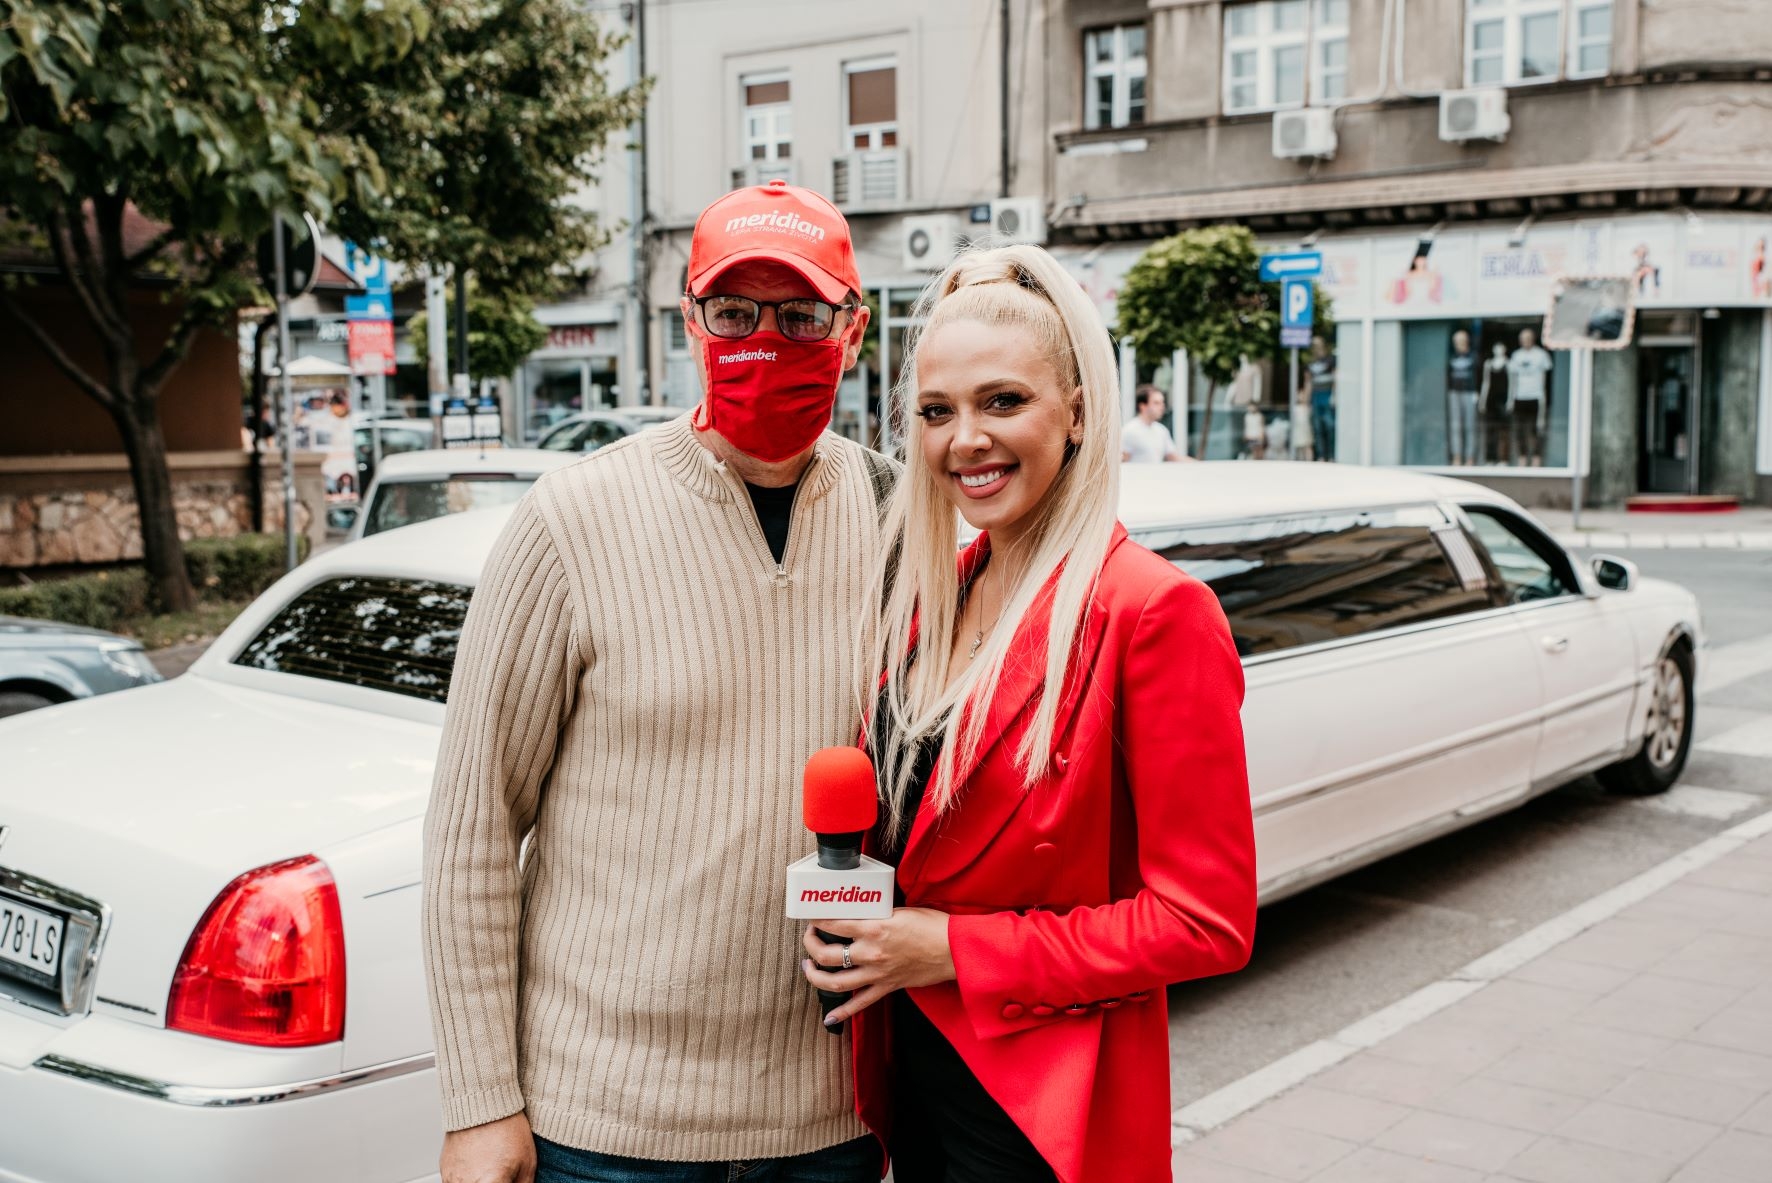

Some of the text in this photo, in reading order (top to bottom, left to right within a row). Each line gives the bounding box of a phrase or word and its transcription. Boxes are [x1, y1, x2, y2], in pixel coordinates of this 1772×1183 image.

[725, 209, 825, 241] meridian
[1288, 284, 1308, 322] P
[718, 348, 778, 364] meridianbet
[800, 886, 882, 903] meridian
